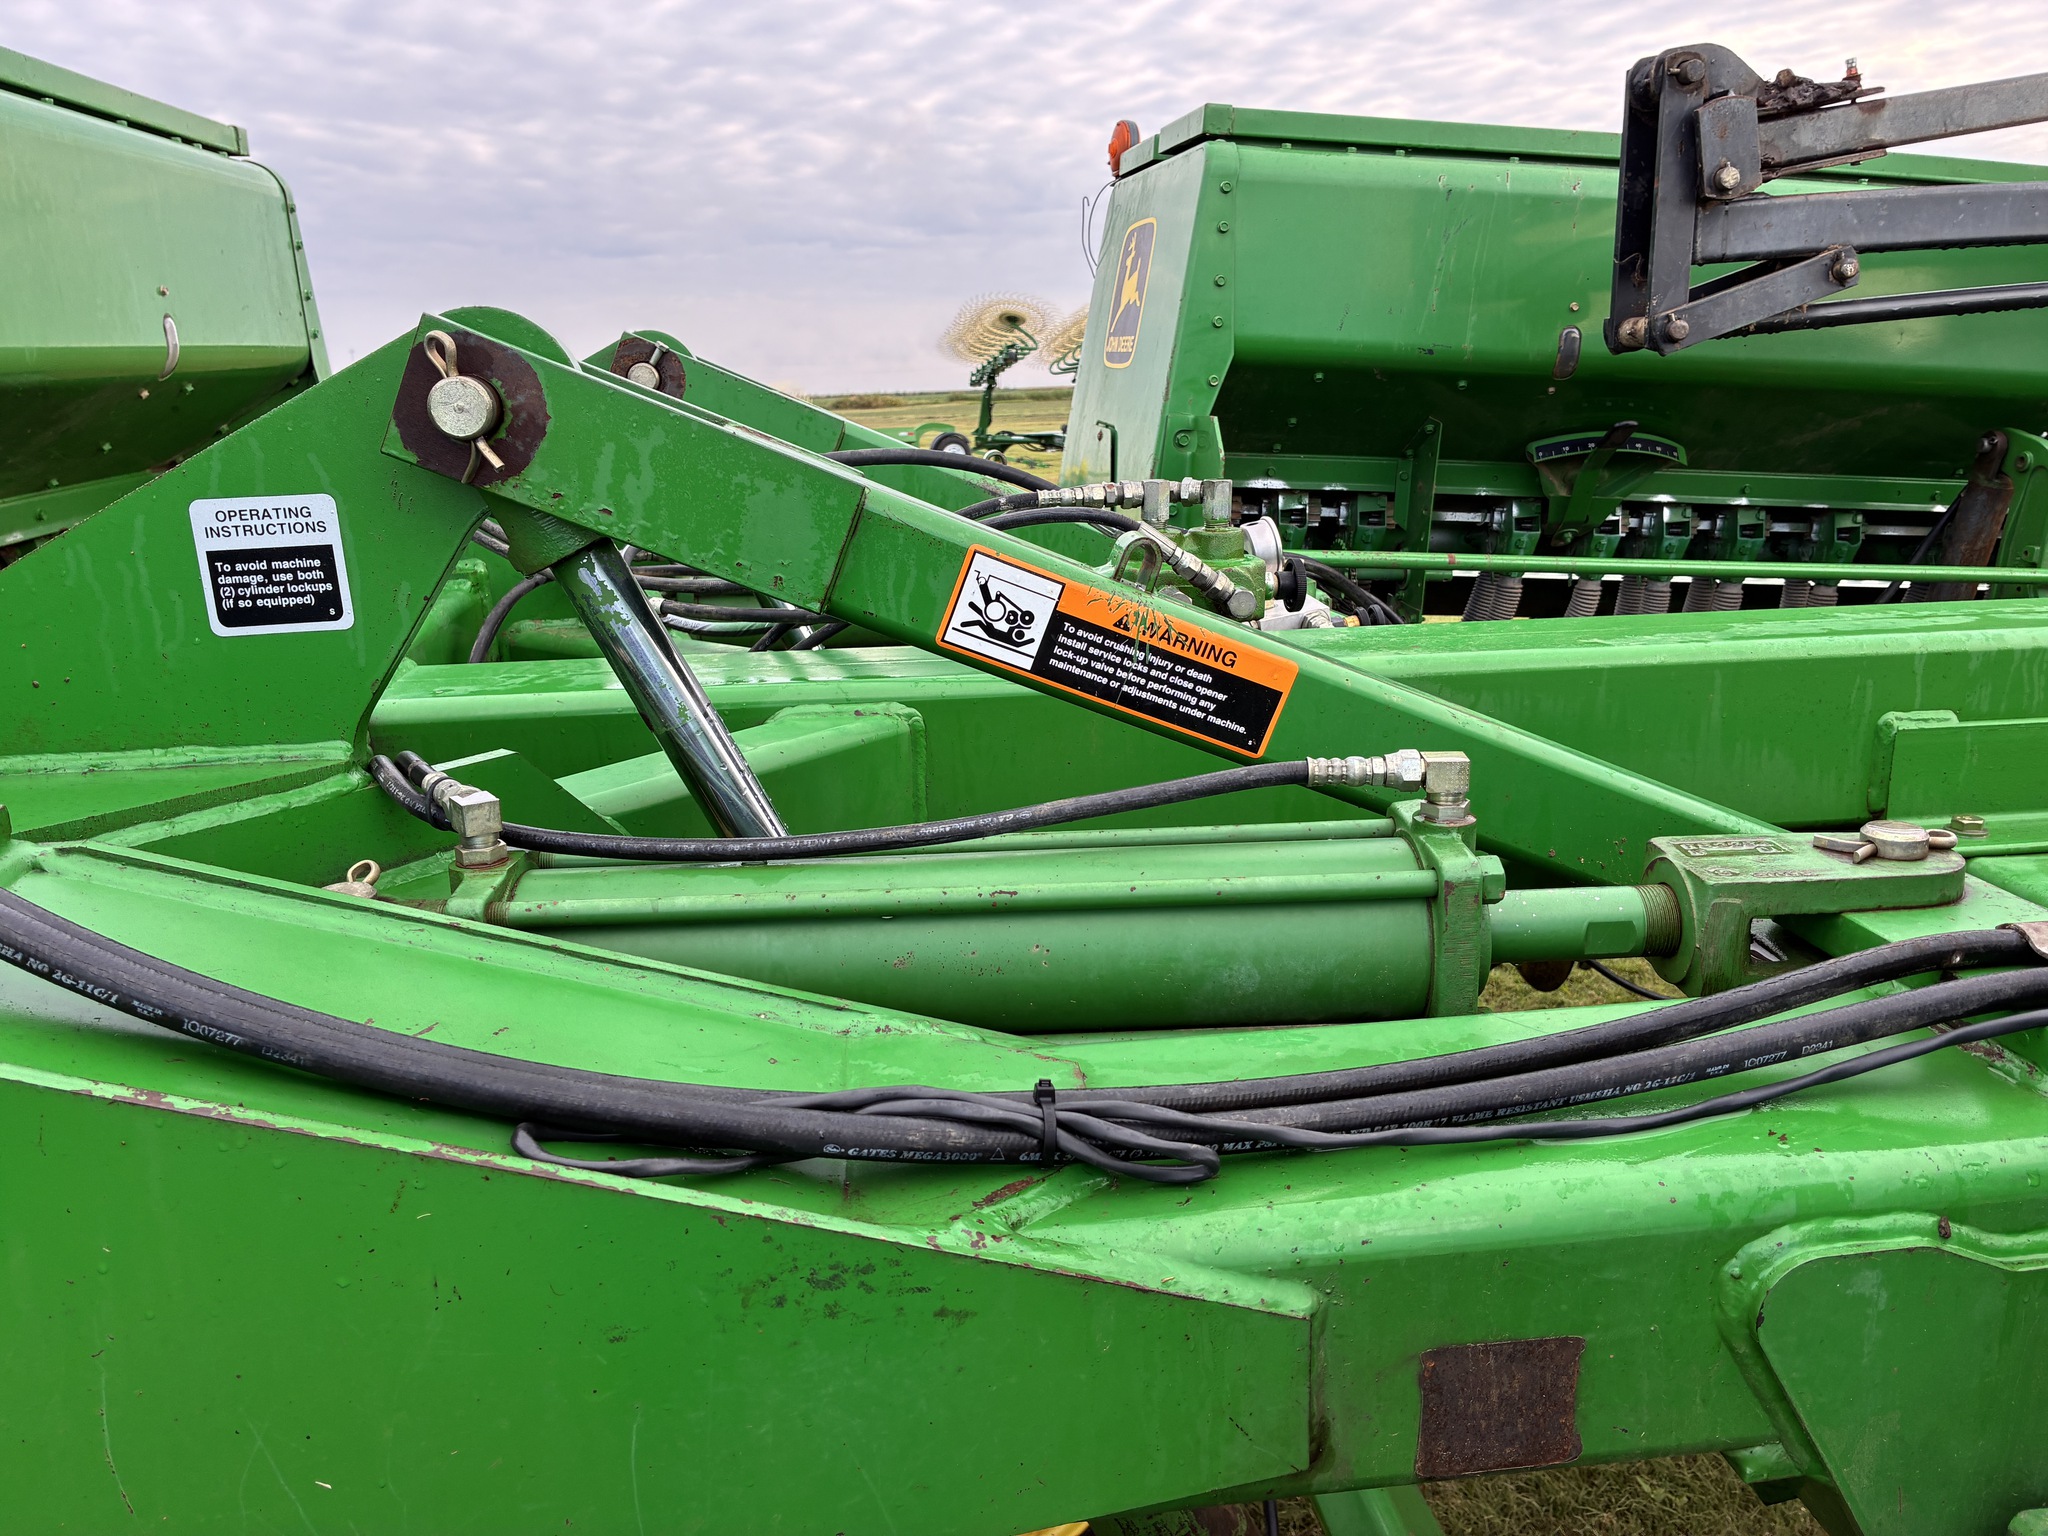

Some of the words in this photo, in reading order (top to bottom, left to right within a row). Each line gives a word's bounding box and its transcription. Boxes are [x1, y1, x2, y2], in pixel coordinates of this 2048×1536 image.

[215, 506, 312, 522] OPERATING
[204, 520, 327, 538] INSTRUCTIONS
[215, 562, 231, 572] To
[235, 560, 267, 572] avoid
[271, 558, 321, 569] machine
[218, 574, 268, 586] damage,
[272, 571, 293, 582] use
[298, 570, 325, 580] both
[220, 586, 235, 599] (2)
[238, 582, 284, 597] cylinder
[287, 581, 333, 593] lockups
[222, 598, 234, 610] (if
[238, 599, 252, 608] so
[256, 594, 315, 607] equipped)
[1064, 622, 1075, 633] To
[1077, 629, 1104, 643] avoid
[1104, 640, 1145, 660] crushing
[1148, 653, 1174, 670] injury
[1175, 664, 1186, 673] or
[1186, 668, 1213, 683] death
[1141, 619, 1237, 668] WARNING
[1058, 634, 1087, 650] install
[1088, 646, 1122, 663] service
[1123, 658, 1148, 673] locks
[1150, 668, 1168, 680] and
[1169, 676, 1194, 689] close
[1195, 686, 1228, 701] opener
[1053, 645, 1088, 666] lock-up
[1091, 660, 1115, 674] valve
[1116, 668, 1146, 685] before
[1146, 681, 1198, 705] performing
[1199, 700, 1216, 712] any
[1049, 658, 1108, 684] maintenance
[1110, 680, 1120, 688] or
[1121, 684, 1178, 709] adjustments
[1179, 704, 1207, 719] under
[1207, 715, 1247, 734] machine.
[1802, 1040, 1834, 1054] D2341
[1451, 1109, 1494, 1123] FLAME
[1495, 1097, 1568, 1116] RESISTANT
[1644, 1071, 1697, 1089] 2G-11C/1
[848, 1147, 897, 1158] GATES
[1223, 1140, 1254, 1150] MAX
